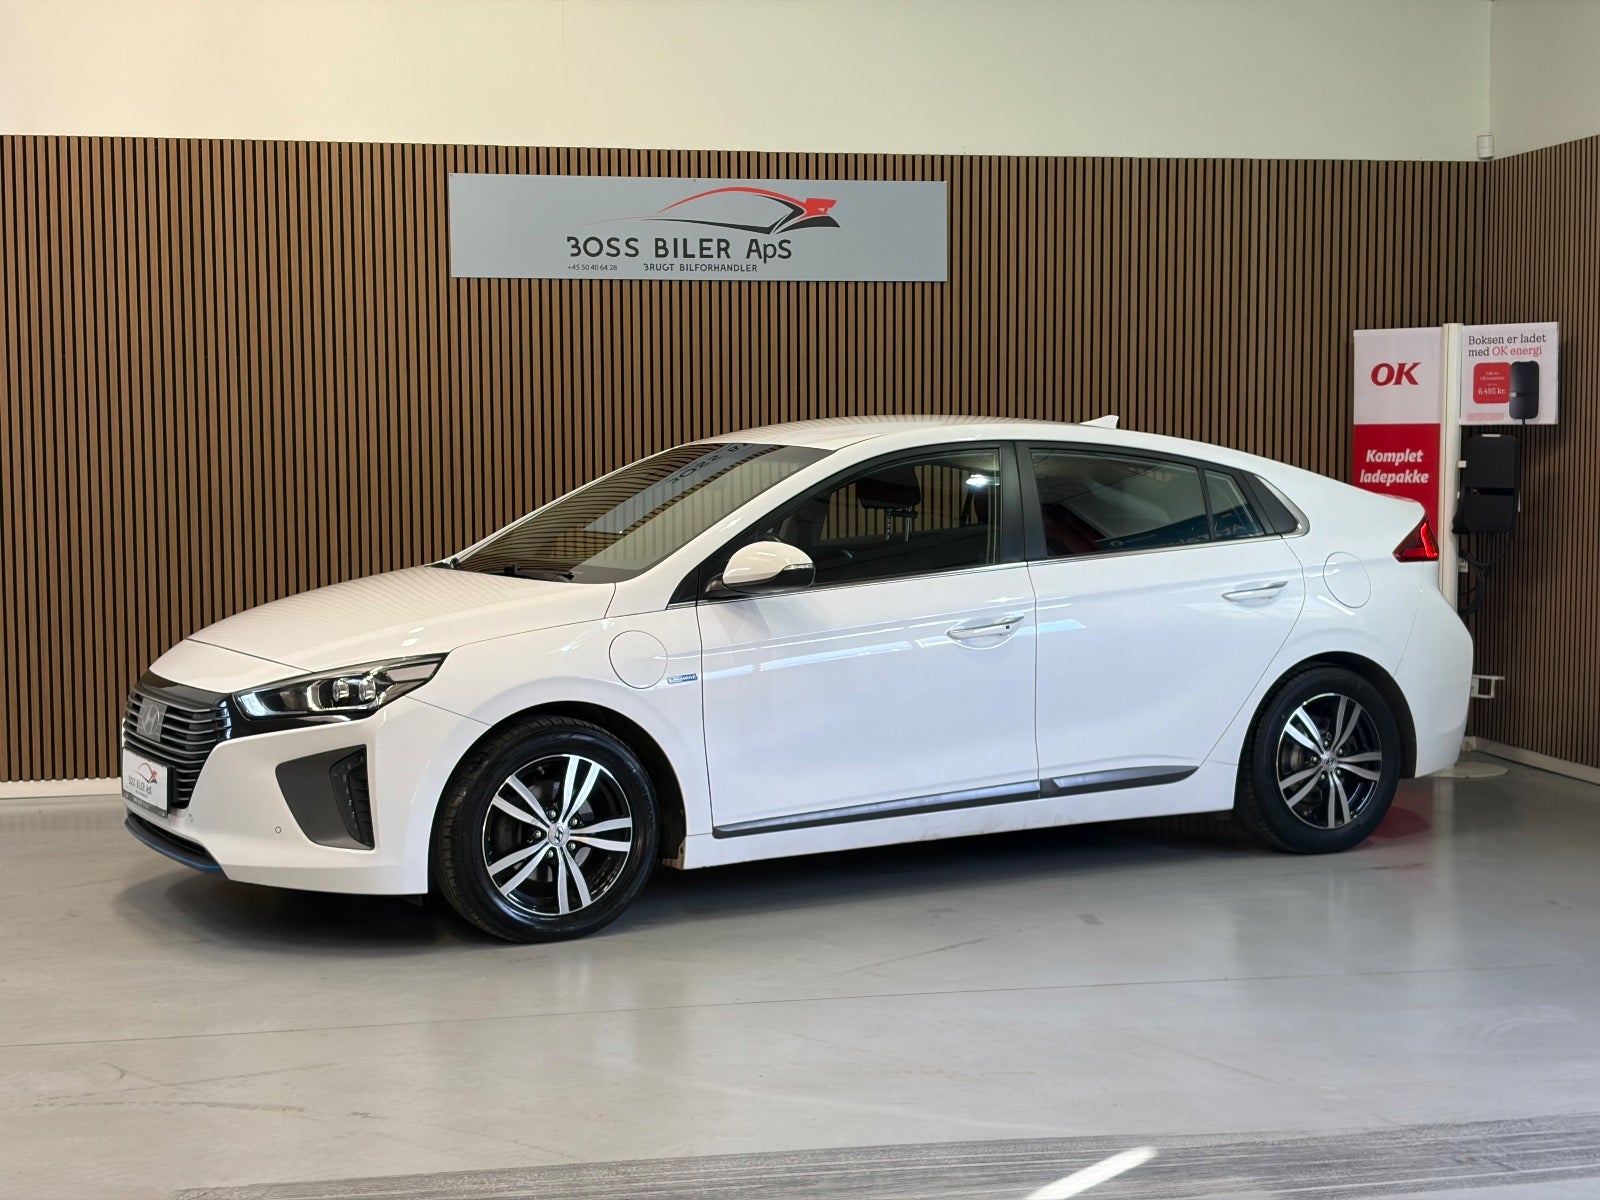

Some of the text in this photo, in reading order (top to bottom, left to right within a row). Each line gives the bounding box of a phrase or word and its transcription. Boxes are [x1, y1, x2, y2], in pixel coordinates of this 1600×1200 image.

[655, 237, 731, 259] BILER
[746, 238, 792, 264] ApS
[581, 263, 590, 271] 50
[679, 263, 758, 273] BILFORHANDLER
[1468, 332, 1547, 346] Boksen er ladet
[1468, 345, 1543, 358] med OK energi
[1371, 362, 1422, 387] OK
[1365, 448, 1424, 467] Komplet
[1360, 468, 1430, 487] ladepakke
